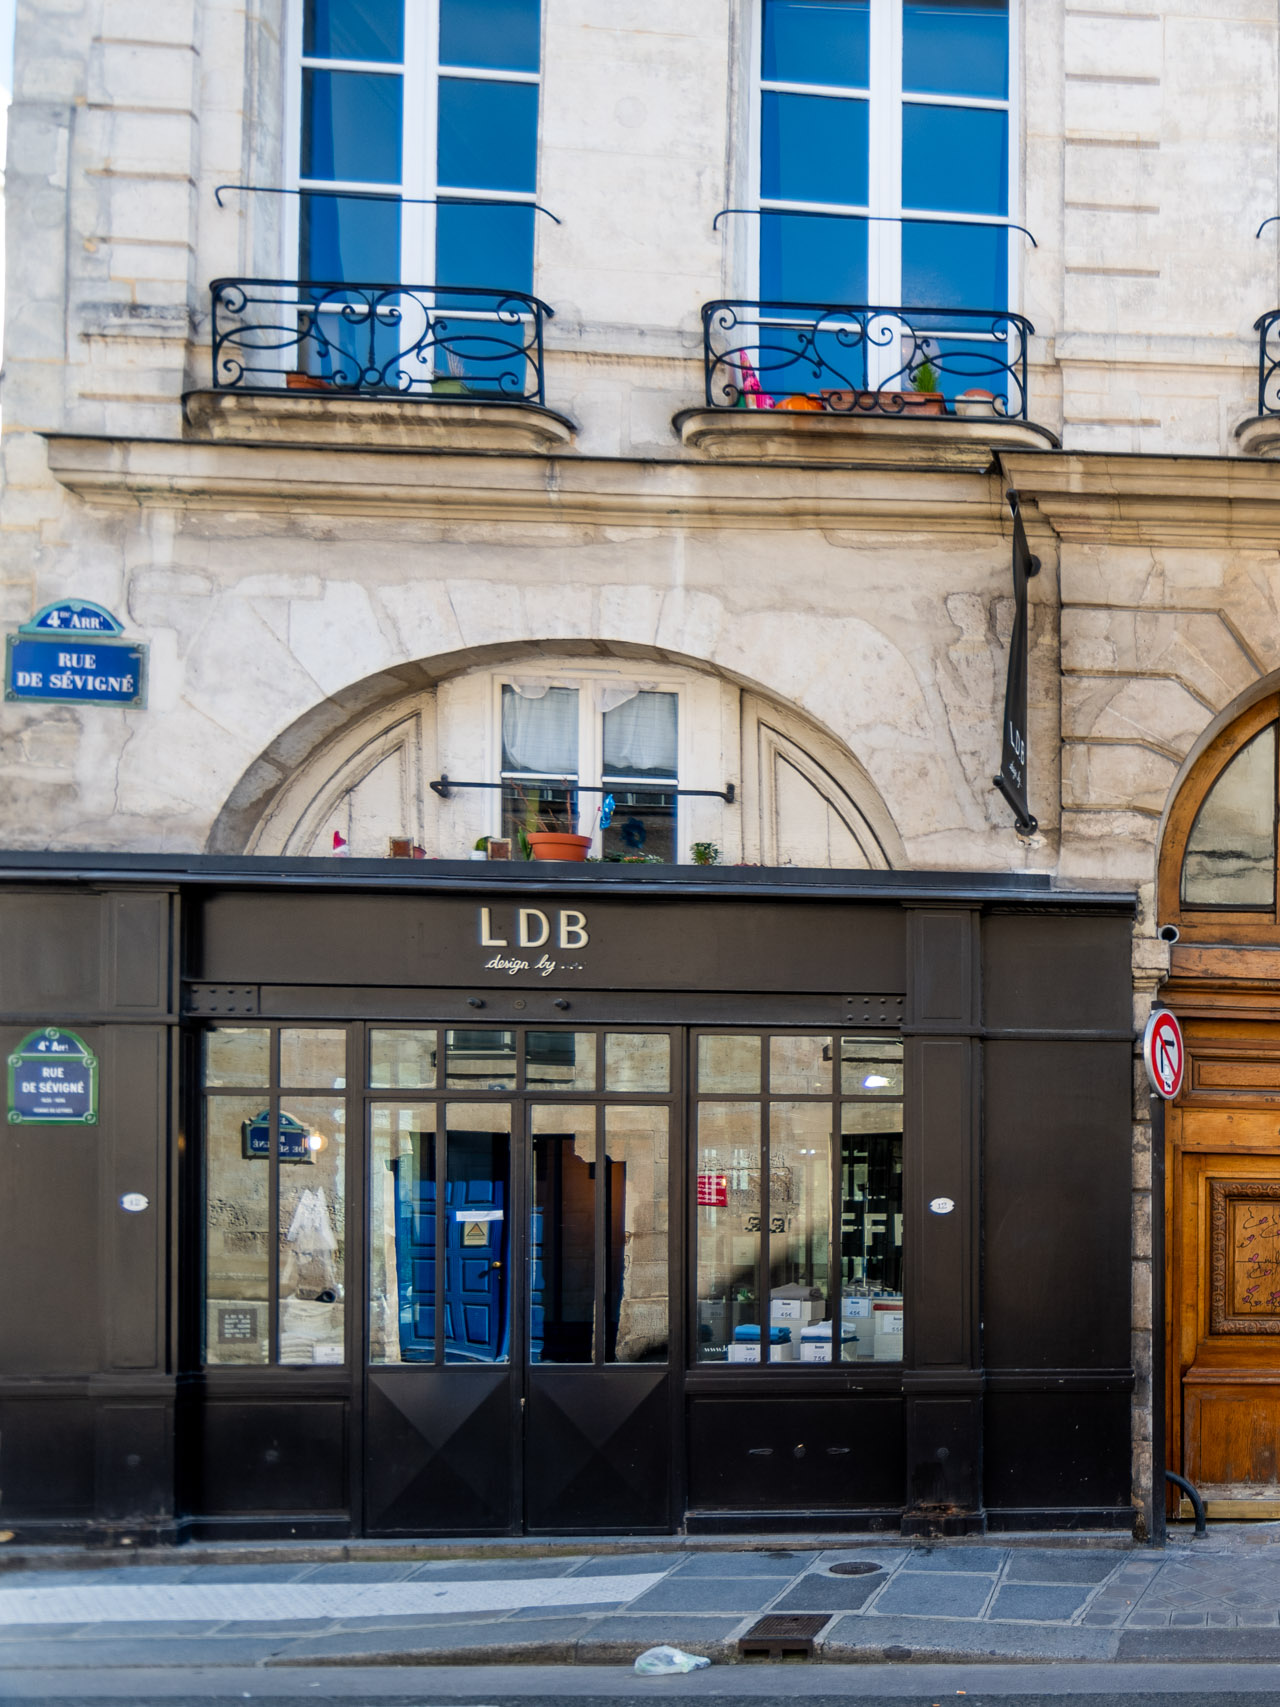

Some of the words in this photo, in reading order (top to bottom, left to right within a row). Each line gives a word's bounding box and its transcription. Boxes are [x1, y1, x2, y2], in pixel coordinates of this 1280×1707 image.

[58, 652, 96, 669] RUE
[16, 672, 43, 687] DE
[49, 670, 134, 693] SÉVIGNÉ
[481, 907, 590, 949] LDB
[485, 954, 531, 975] design
[535, 953, 556, 977] by
[42, 1067, 64, 1078] RUE
[22, 1082, 37, 1093] DE
[39, 1080, 85, 1094] SÉVIGNÉ
[937, 1201, 948, 1209] 12
